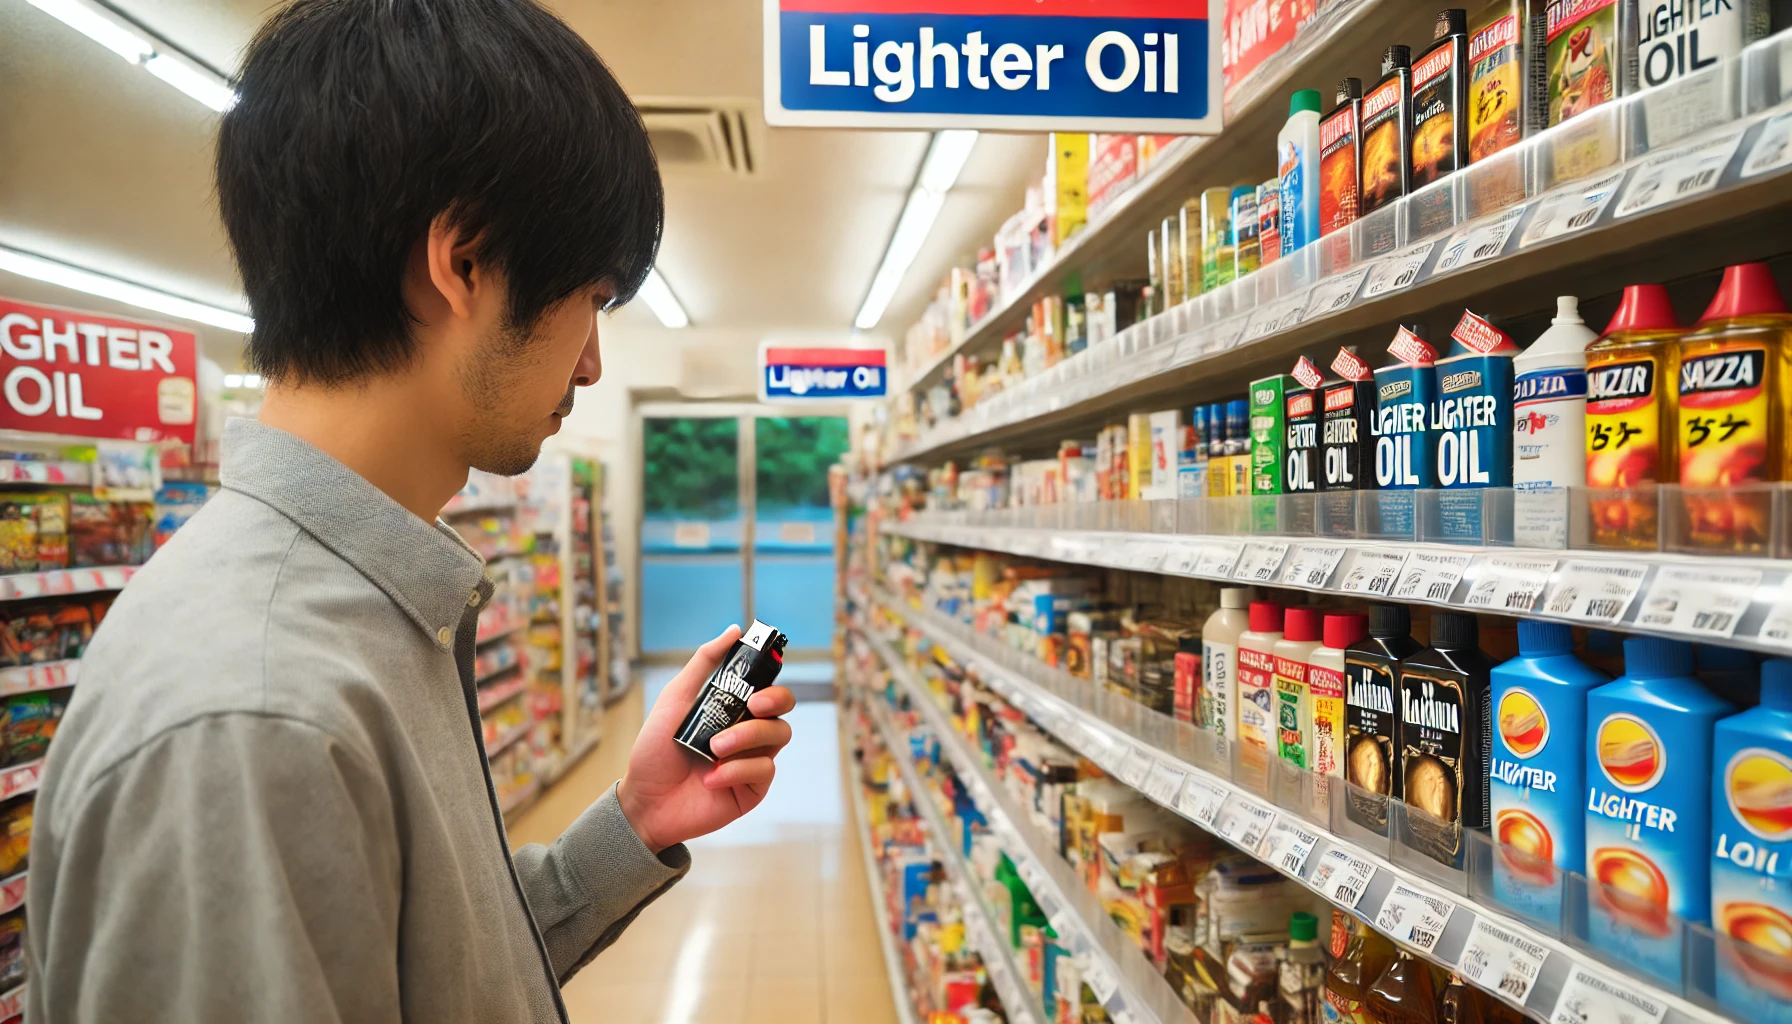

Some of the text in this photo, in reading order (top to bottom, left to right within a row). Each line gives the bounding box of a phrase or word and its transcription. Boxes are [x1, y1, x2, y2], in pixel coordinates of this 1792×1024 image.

[810, 25, 1063, 102] Lighter
[1085, 31, 1178, 93] Oil
[1644, 29, 1718, 87] OIL
[4, 366, 103, 420] OIL
[1288, 450, 1314, 491] OIL
[1326, 447, 1353, 484] OIL
[1376, 435, 1419, 486] OIL
[1438, 430, 1489, 486] OIL
[1588, 787, 1677, 832] LIGHTER
